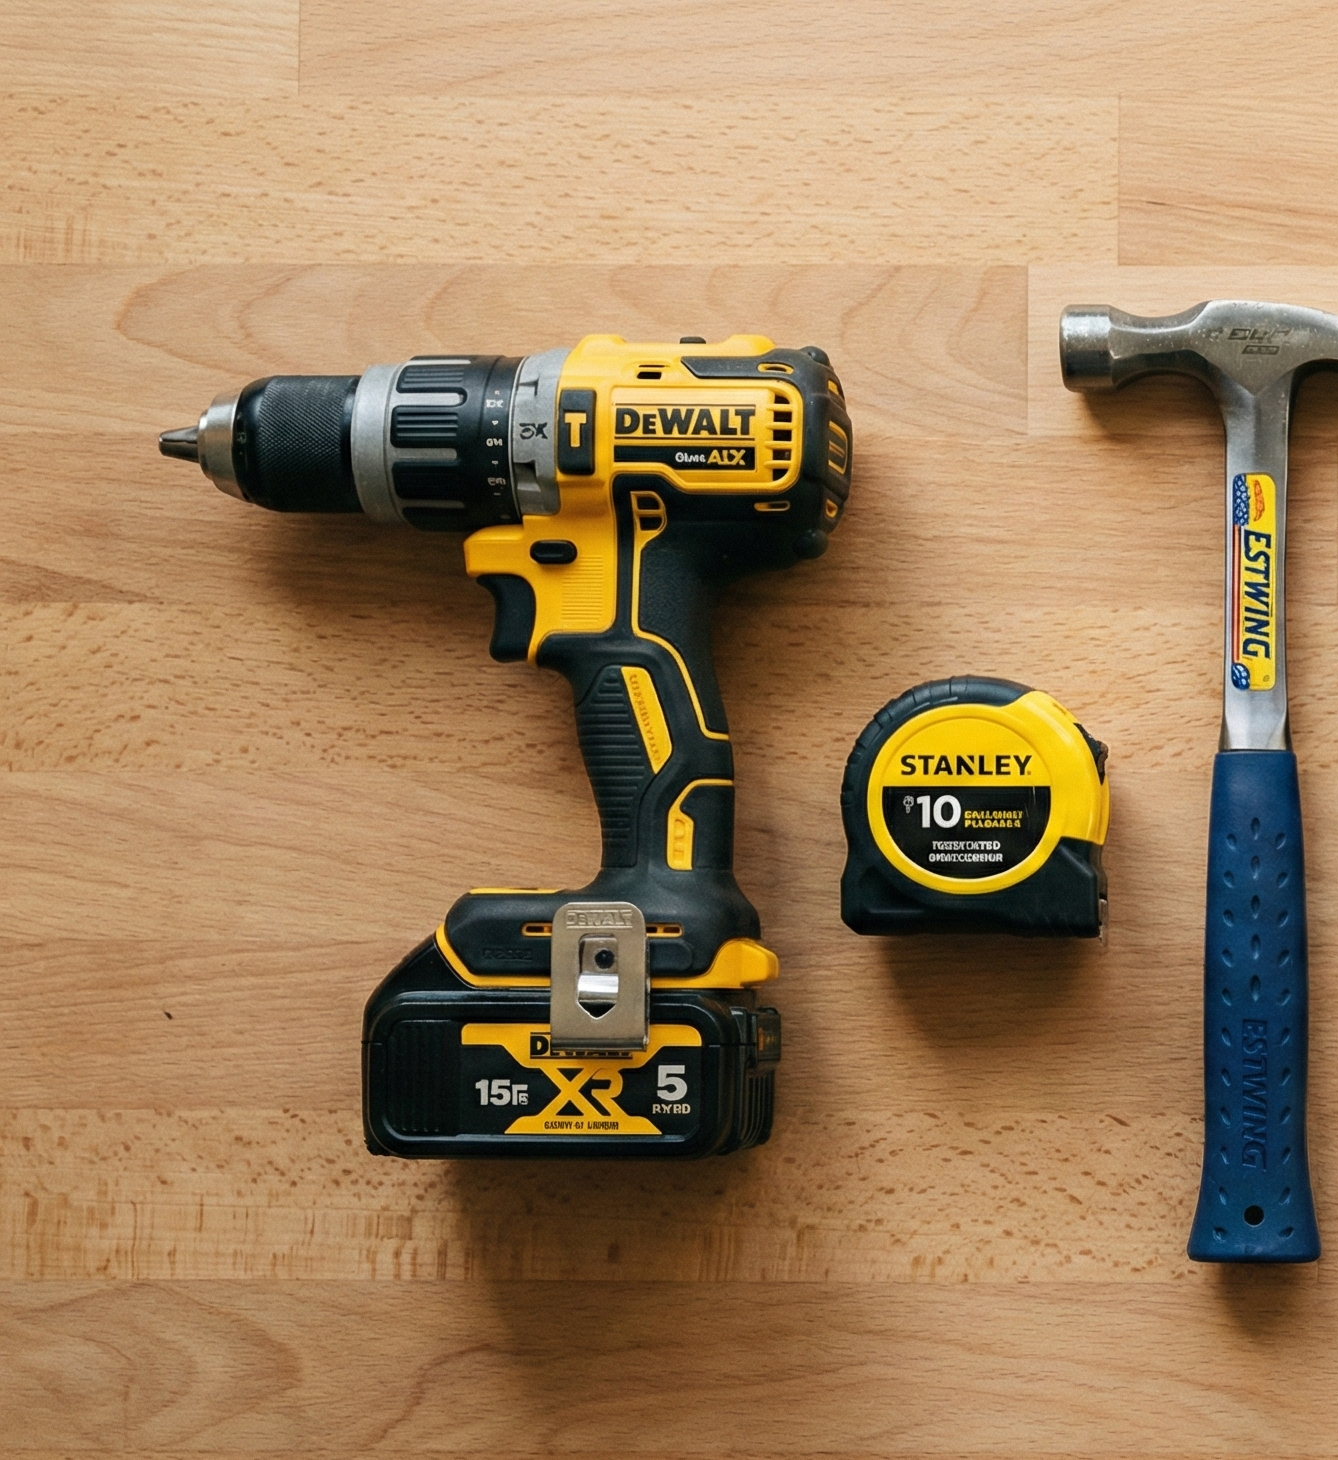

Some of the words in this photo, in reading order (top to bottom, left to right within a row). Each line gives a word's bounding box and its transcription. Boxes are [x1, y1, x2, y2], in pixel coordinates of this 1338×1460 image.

[1243, 529, 1272, 661] ESTWING
[901, 755, 1032, 776] STANLEY
[916, 795, 962, 828] 10
[540, 1067, 629, 1116] XR
[656, 1065, 688, 1101] 5
[1242, 1019, 1267, 1173] ESTWING
